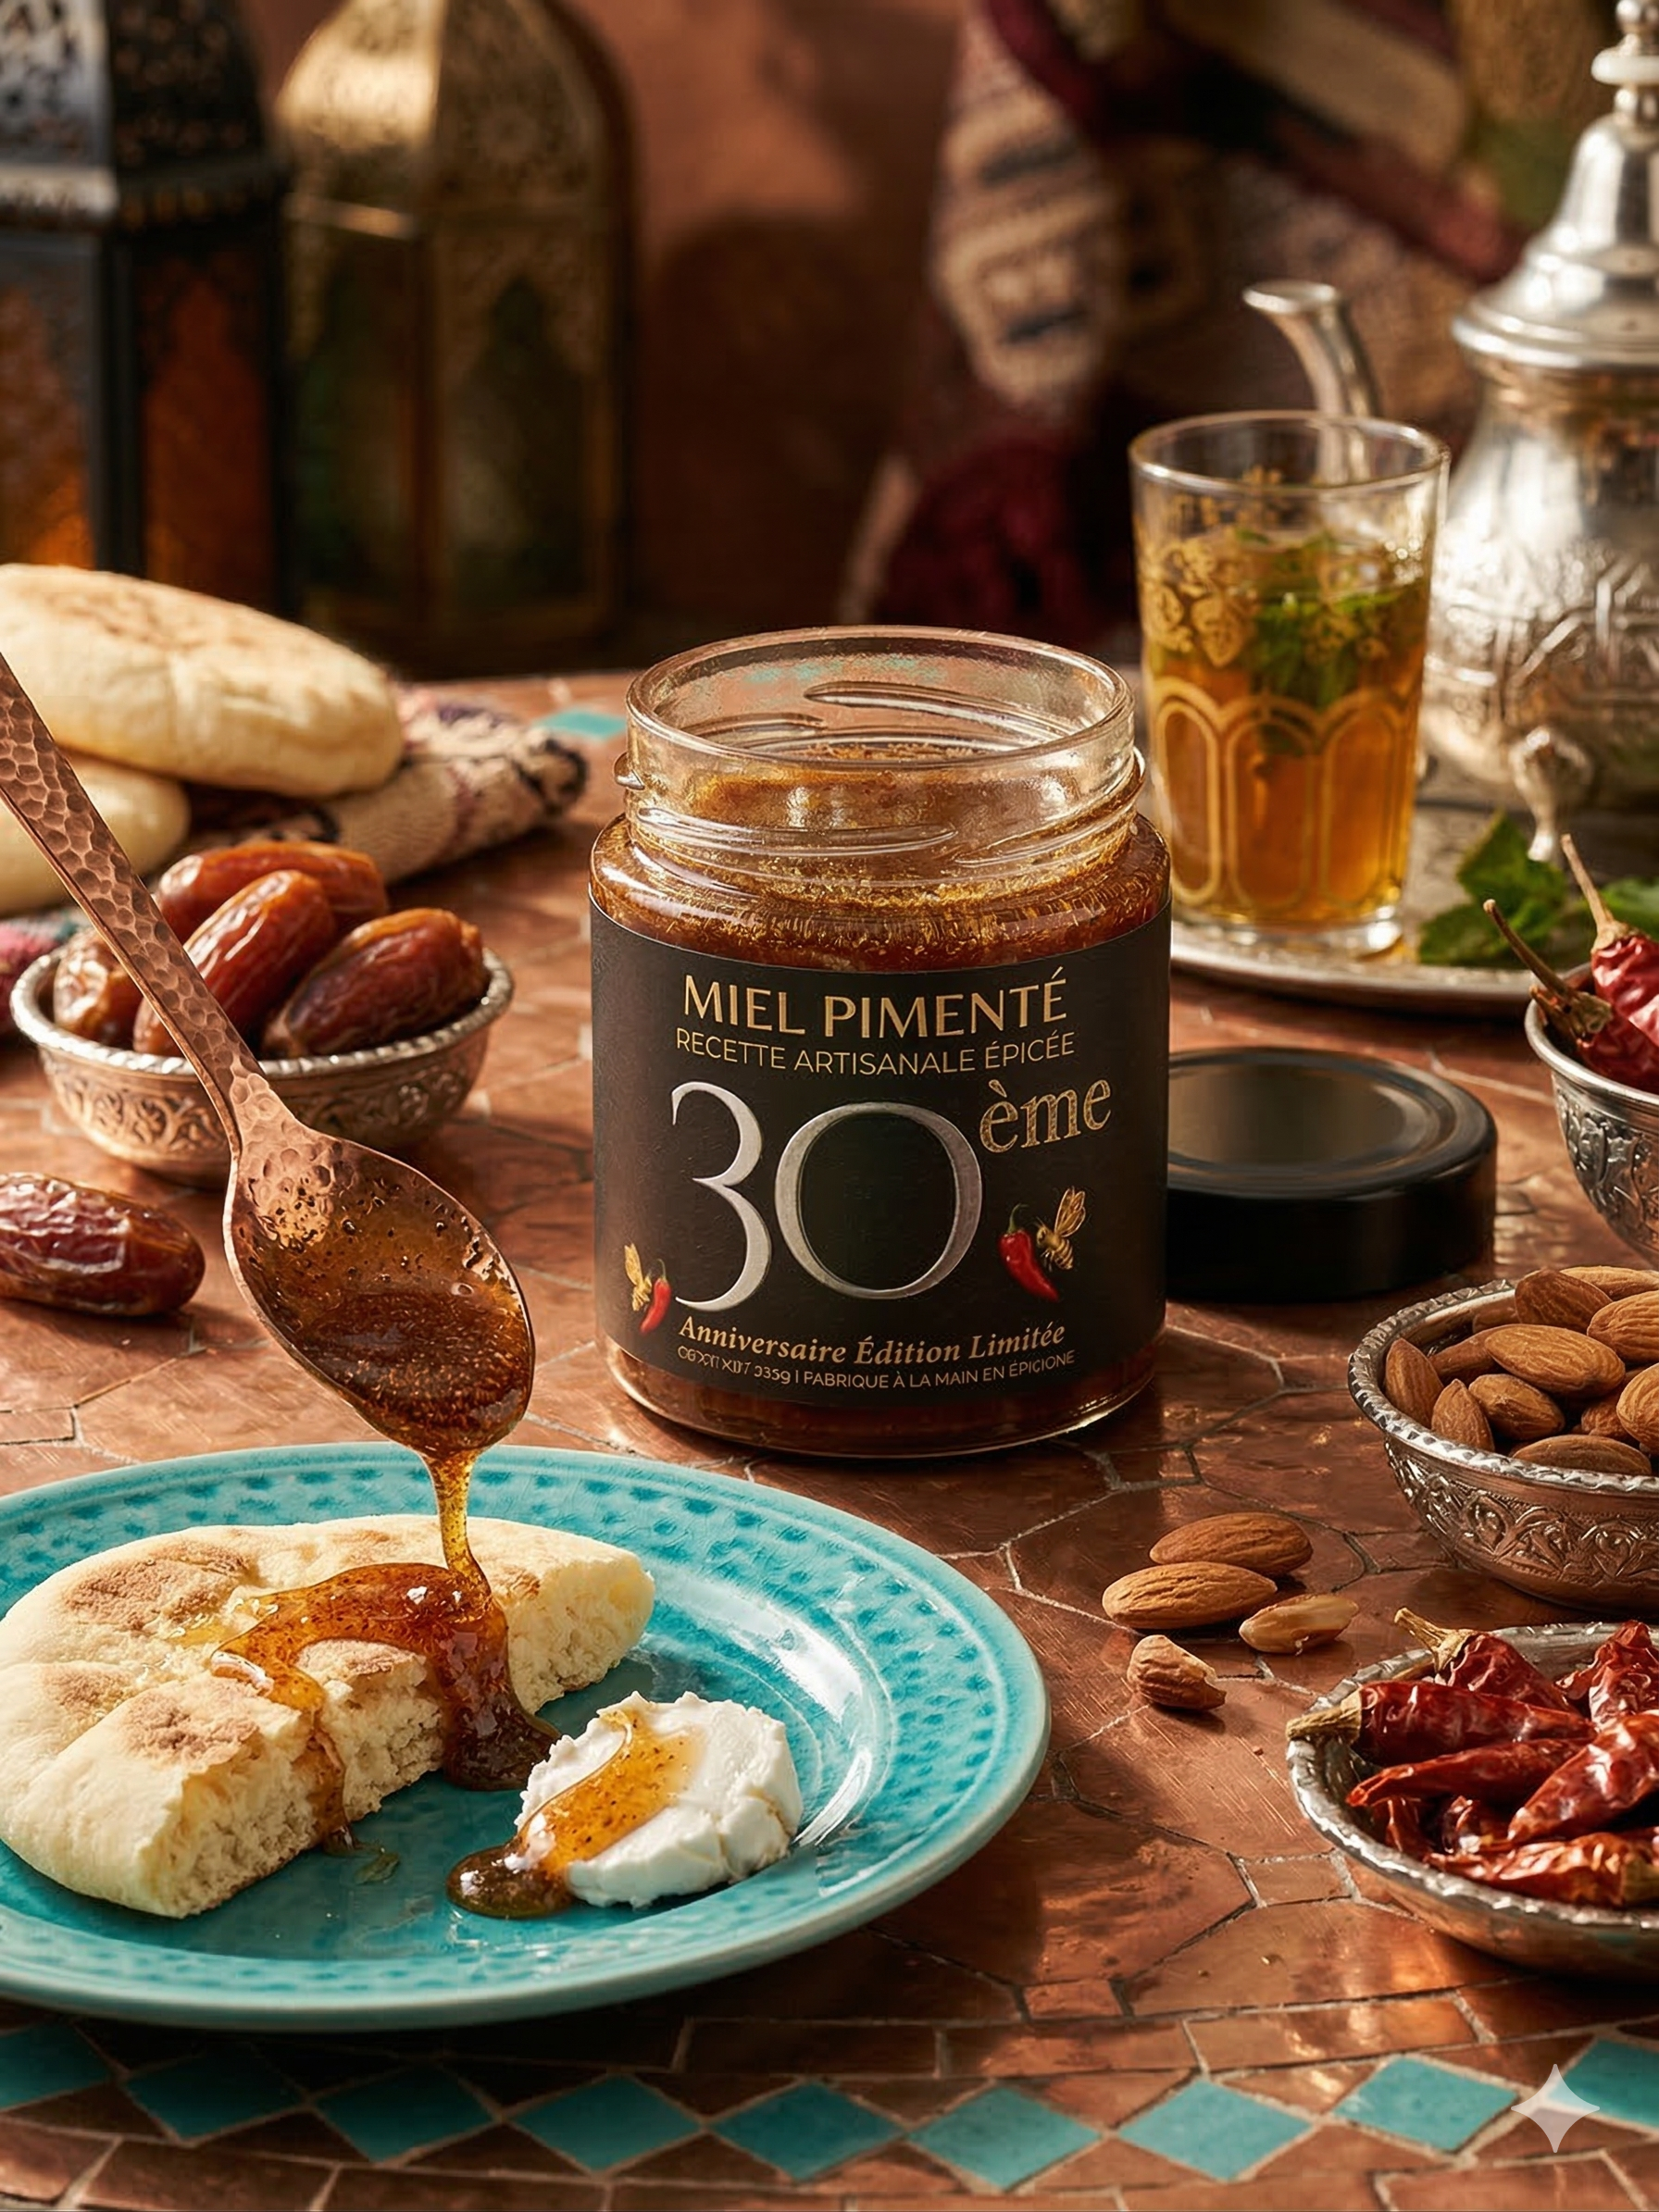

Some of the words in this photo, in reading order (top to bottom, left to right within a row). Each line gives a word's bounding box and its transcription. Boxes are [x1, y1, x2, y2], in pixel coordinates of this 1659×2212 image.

[683, 974, 806, 1037] MIEL
[825, 966, 1068, 1039] PIMENTÉ
[676, 1027, 786, 1070] RECETTE
[793, 1047, 976, 1075] ARTISANALE
[984, 1028, 1076, 1070] ÉPICÉE
[670, 1080, 984, 1312] 30
[978, 1077, 1114, 1155] ème
[678, 1315, 846, 1364] Anniversaire
[854, 1335, 961, 1365] Édition
[968, 1321, 1066, 1359] Limitée
[892, 1370, 905, 1388] À
[910, 1373, 931, 1387] LA
[935, 1369, 979, 1386] MAIN
[982, 1365, 1005, 1382] EN
